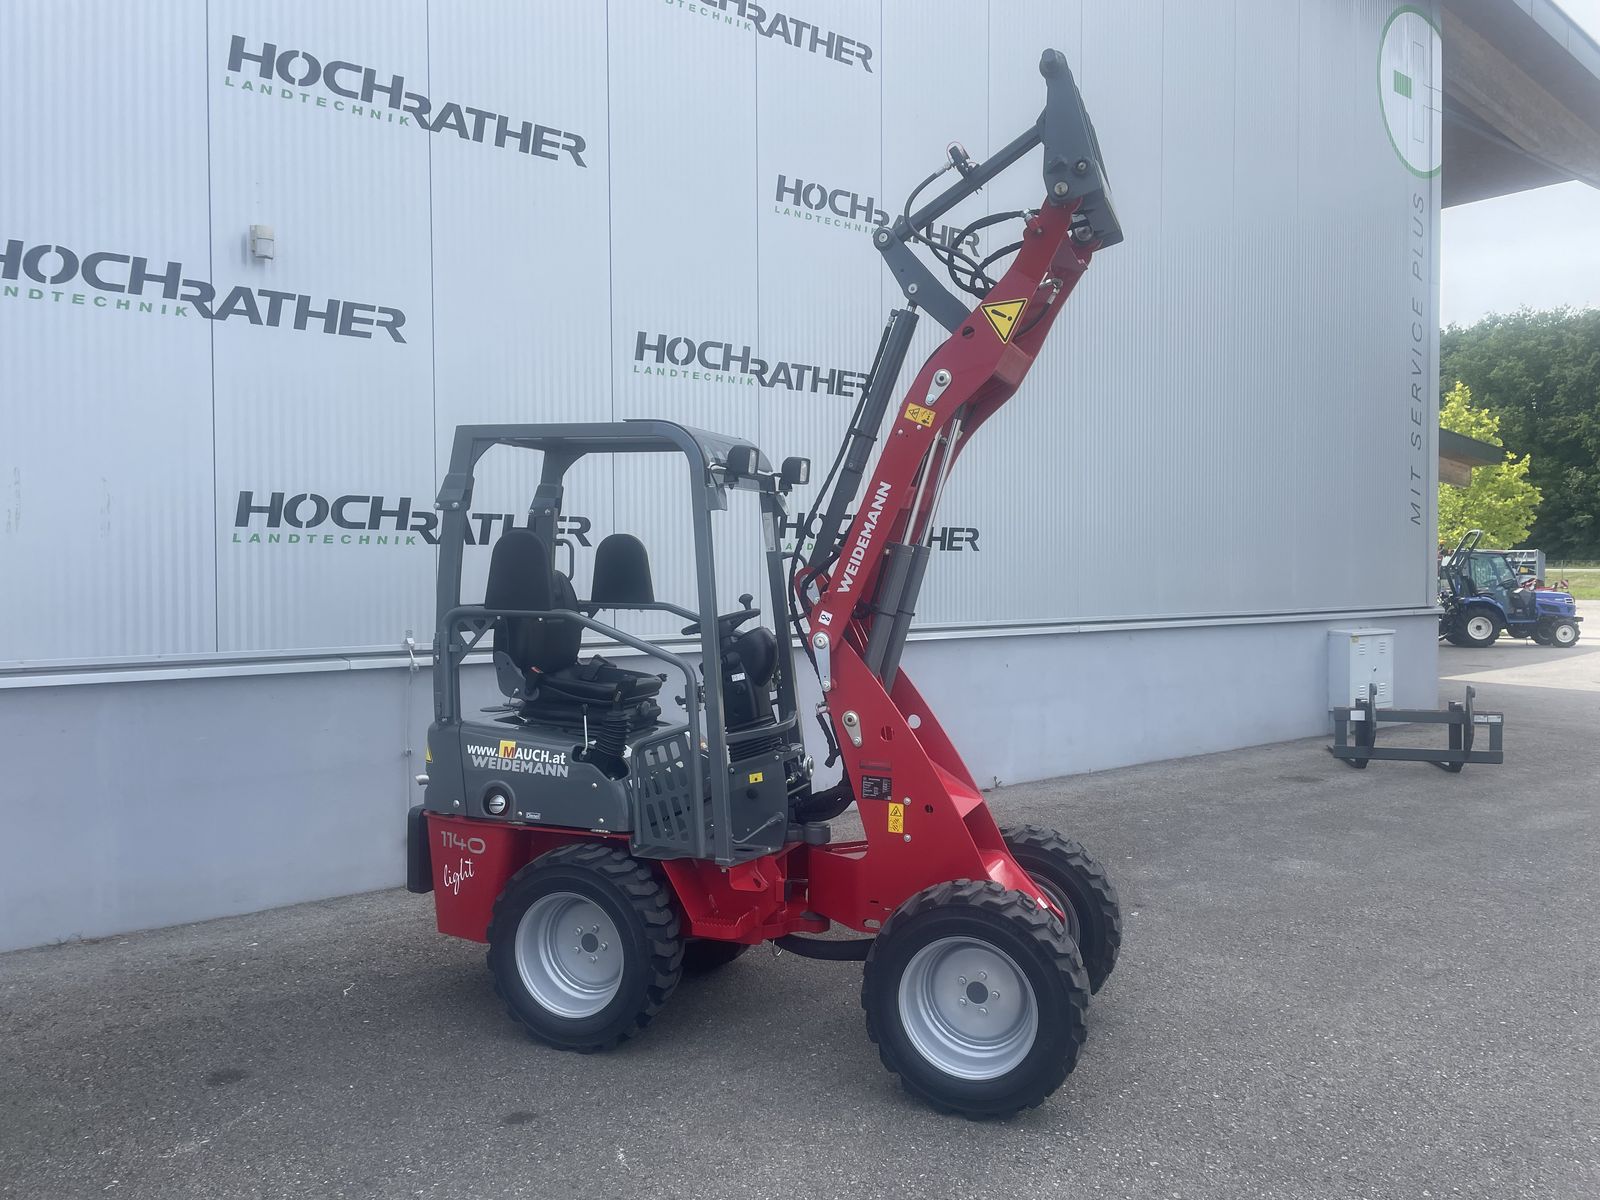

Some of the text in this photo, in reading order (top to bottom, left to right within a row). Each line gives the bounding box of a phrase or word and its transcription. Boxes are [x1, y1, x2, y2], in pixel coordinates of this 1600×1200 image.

[224, 76, 410, 126] LANDTECHNIK
[227, 34, 587, 168] HOCHRATHER
[3, 285, 188, 318] NDTECHNIK
[633, 364, 755, 386] LANDTECHNIK
[1410, 192, 1425, 526] MIT SERVICE PLUS
[232, 533, 417, 546] LANDTECHNIK
[837, 481, 892, 593] WEIDEMANN
[467, 744, 567, 765] www.MAUCH.at
[471, 755, 569, 778] WEIDEMANN
[440, 831, 486, 854] 1140
[443, 857, 475, 895] light
